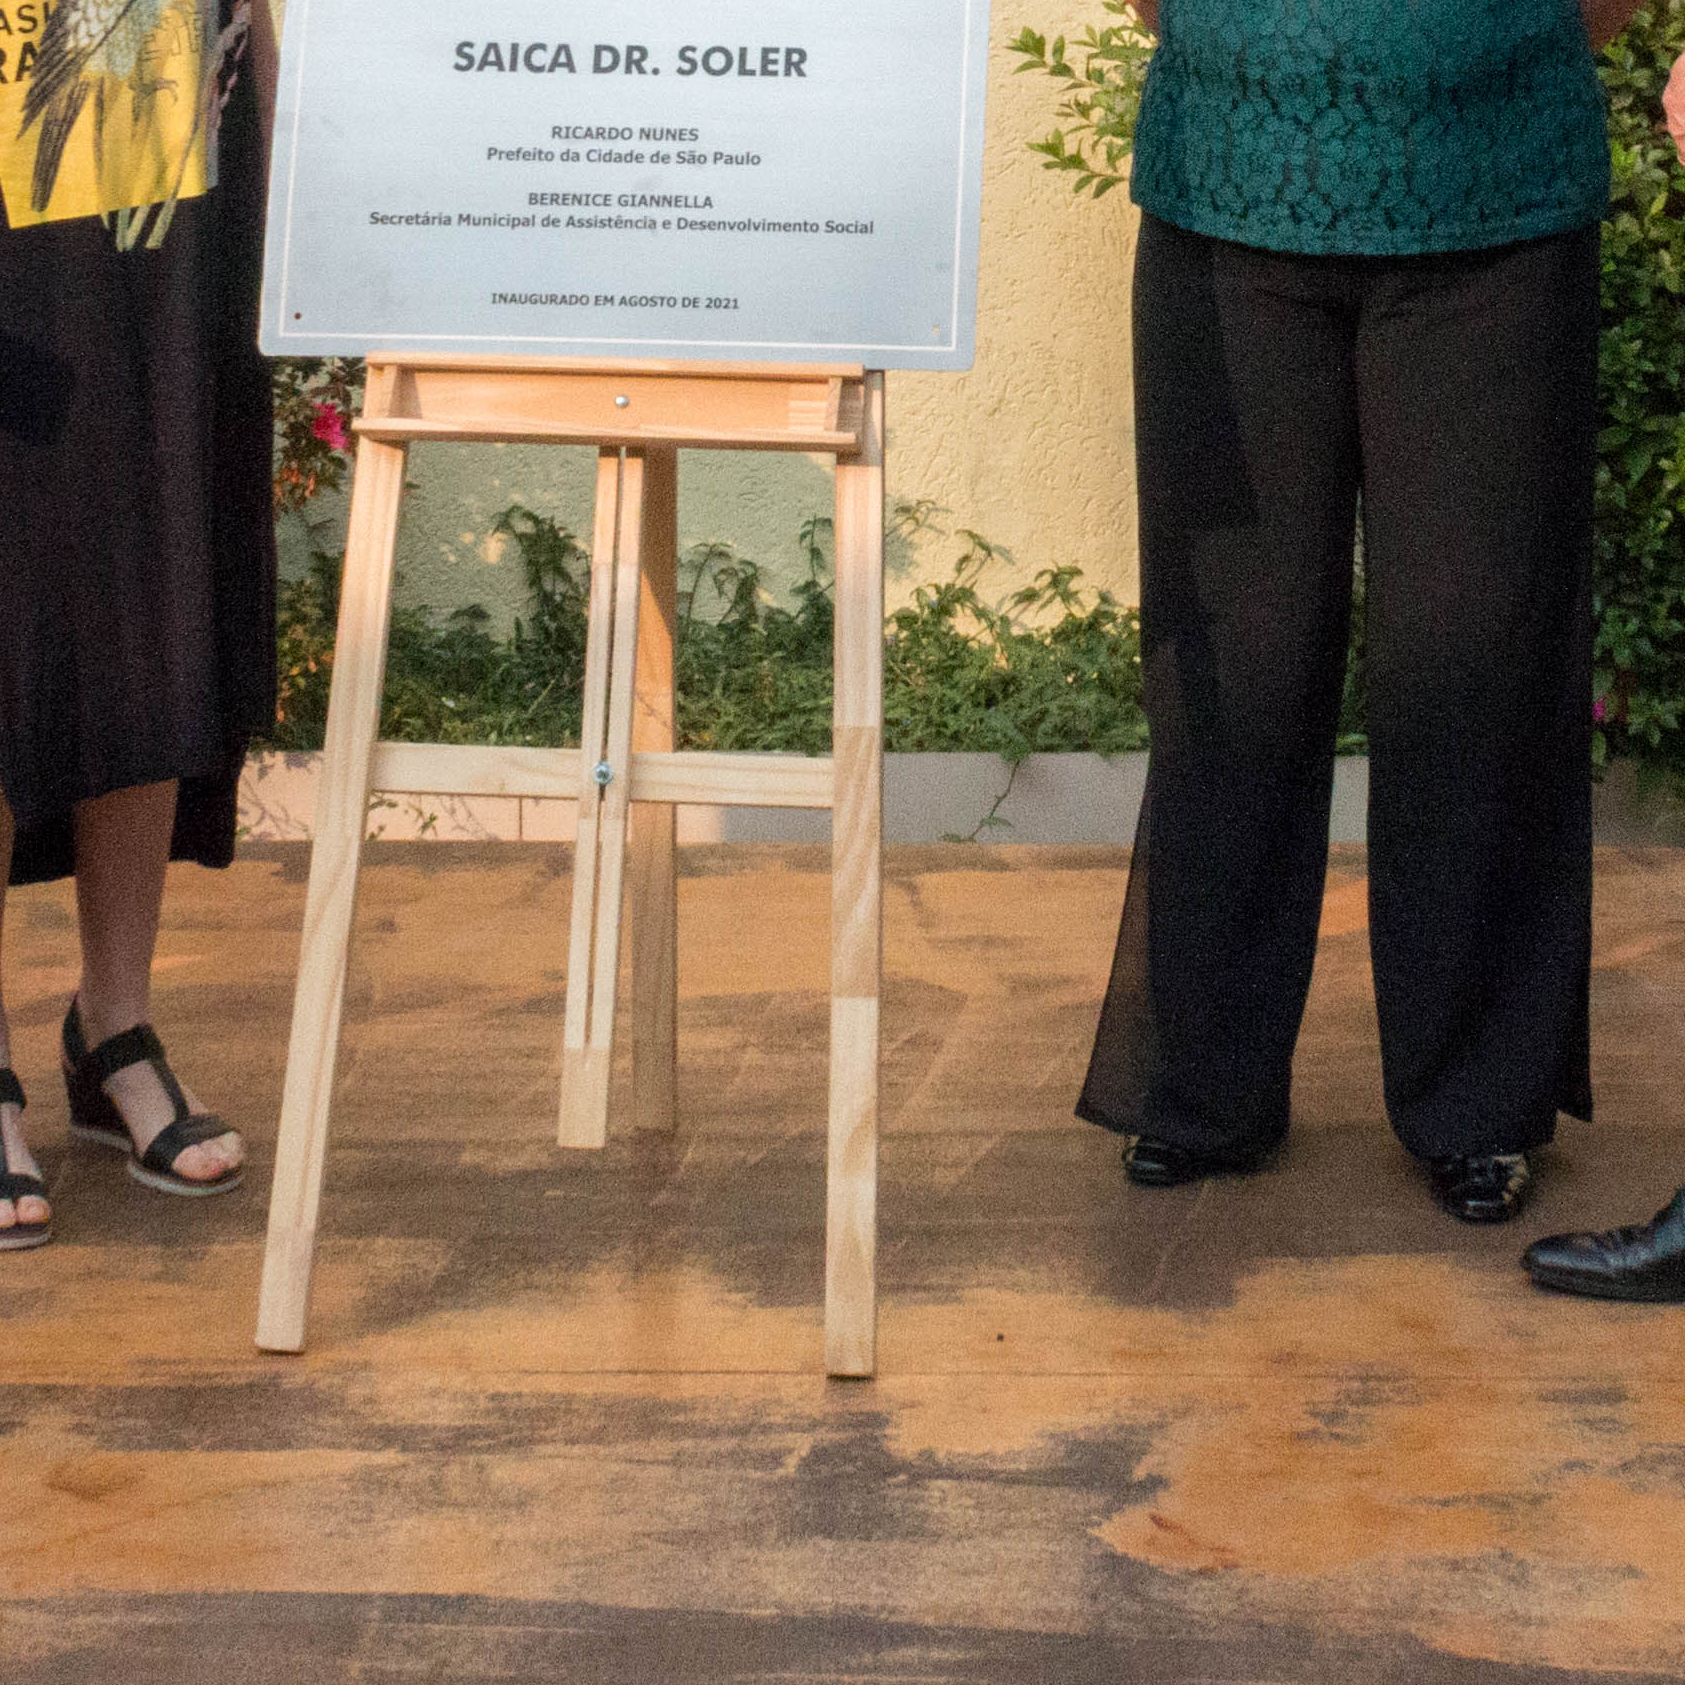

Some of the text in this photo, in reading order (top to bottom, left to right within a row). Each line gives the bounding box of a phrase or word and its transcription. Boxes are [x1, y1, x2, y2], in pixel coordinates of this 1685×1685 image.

[453, 40, 809, 78] SAICA DR. SOLER
[551, 126, 699, 142] RICARDO NUNES
[487, 147, 761, 166] Prefeito da Cidade de São Paulo
[528, 193, 714, 209] BERENICE GIANNELLA
[369, 212, 874, 234] Secretária Municipal de Assistência e Desenvolvimento Social
[491, 293, 740, 309] INAUGURADO EM AGOSTO DE 2021
